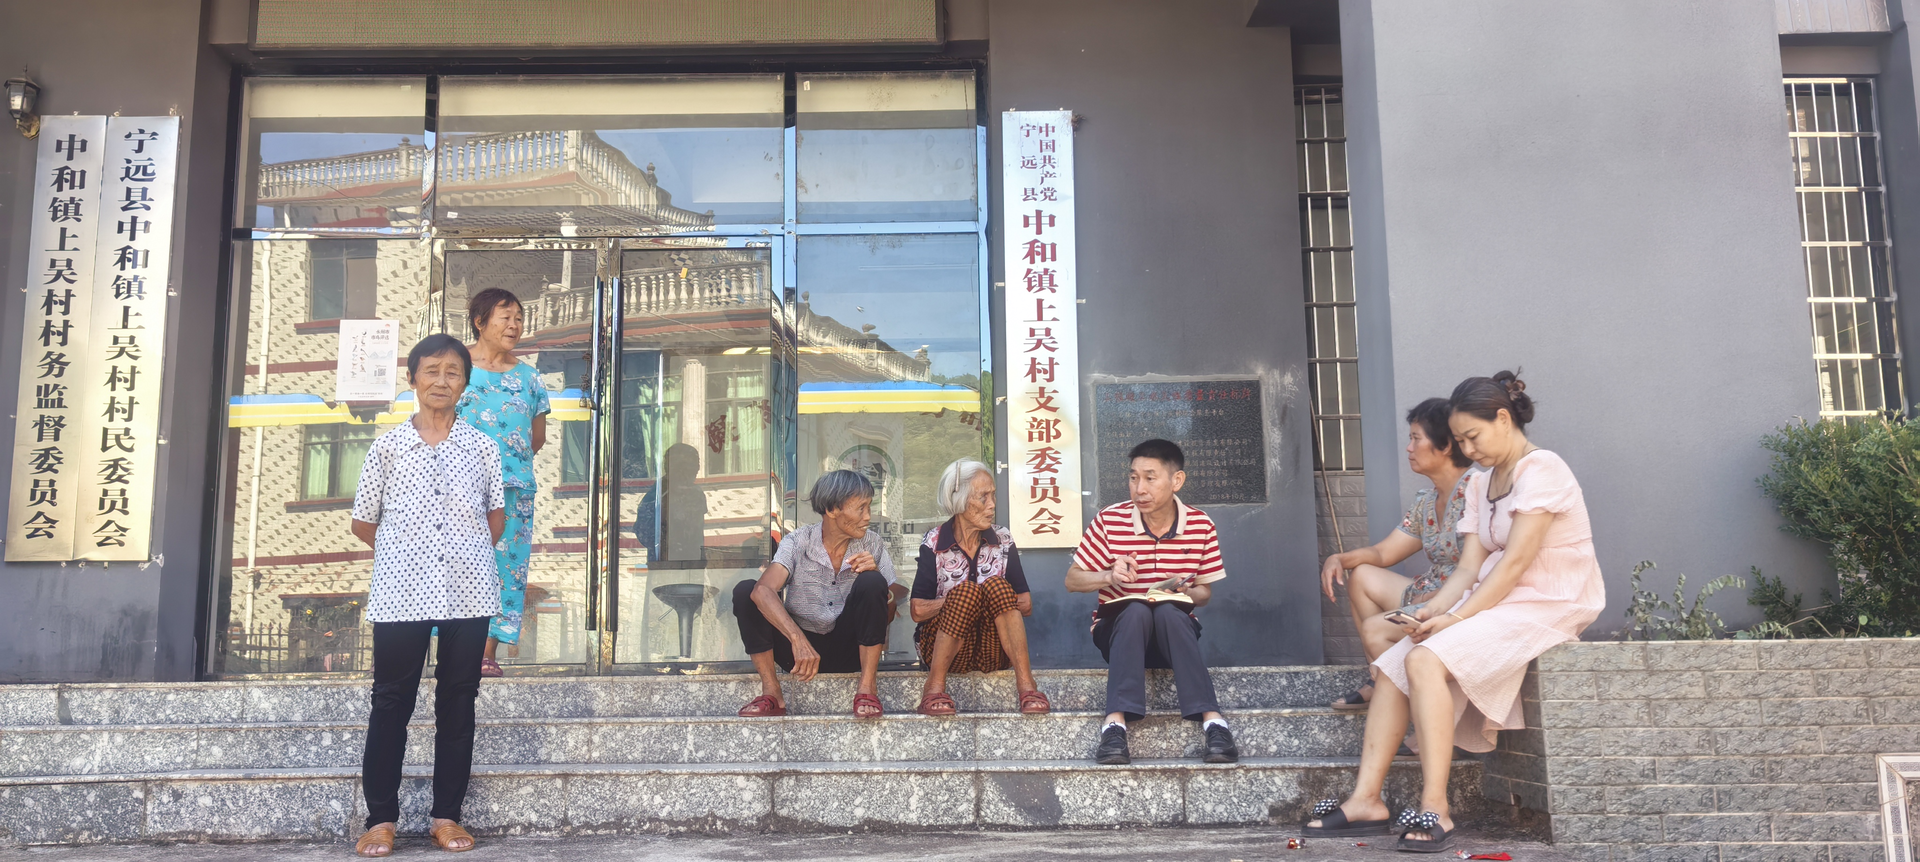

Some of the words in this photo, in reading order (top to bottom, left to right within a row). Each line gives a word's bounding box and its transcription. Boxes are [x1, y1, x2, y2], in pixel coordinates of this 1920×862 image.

[1020, 123, 1038, 202] 宁远县
[1039, 123, 1057, 202] 中国共产党
[22, 133, 88, 540] 中和镇上吴村村务监督委员会
[92, 127, 158, 548] 宁远县中和镇上吴村村民委员会
[1022, 209, 1065, 535] 中和镇上吴村支部委员会
